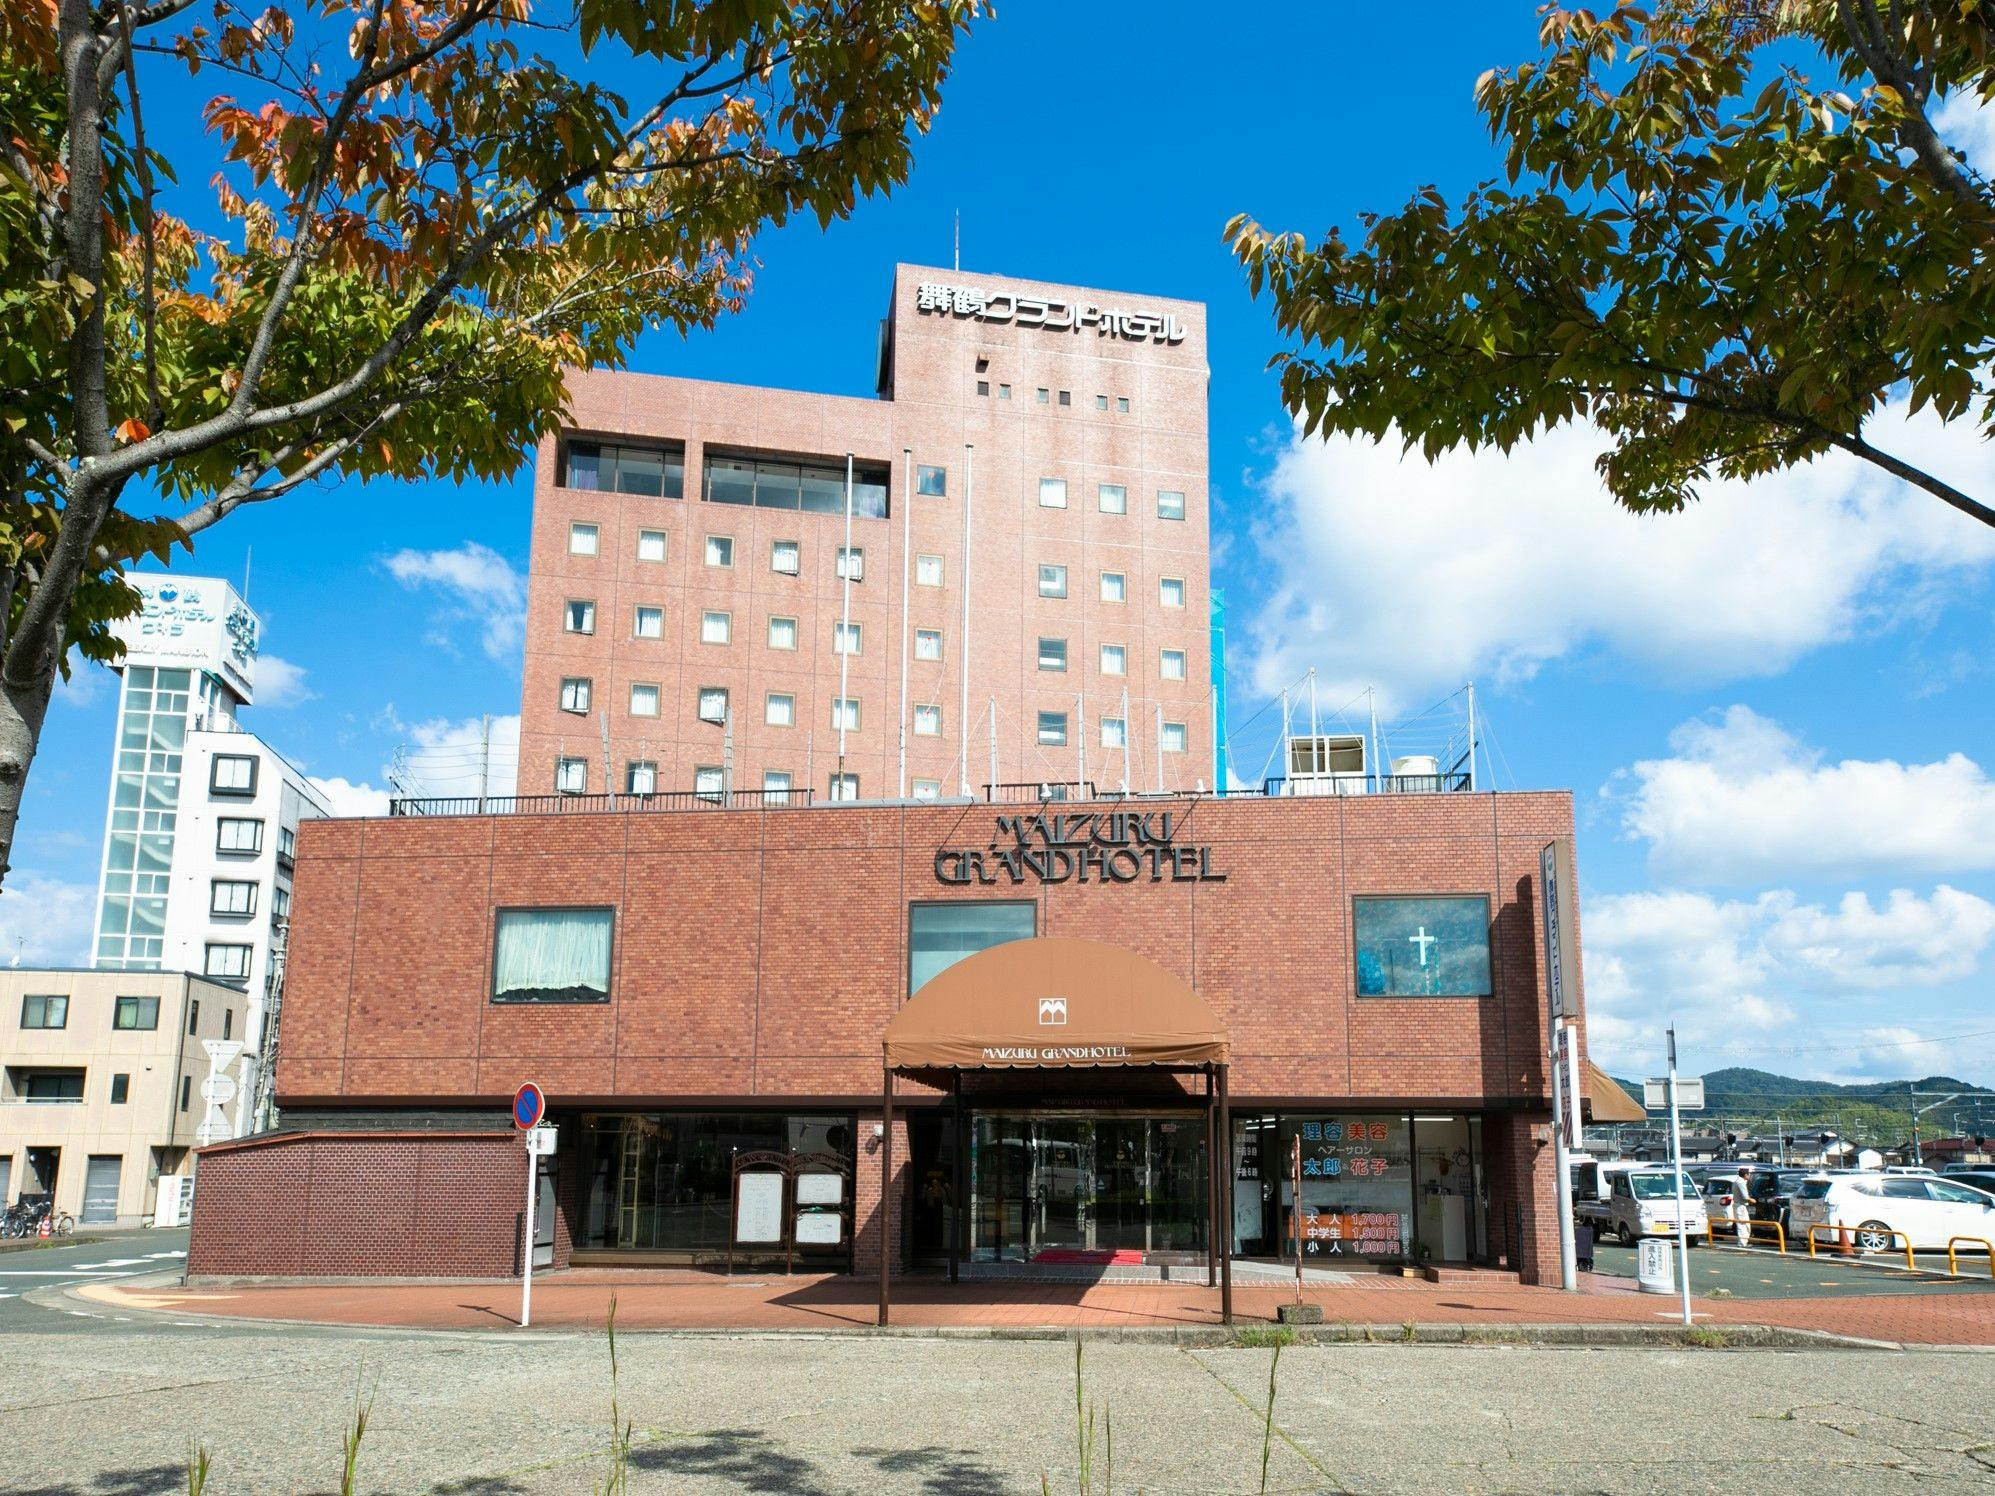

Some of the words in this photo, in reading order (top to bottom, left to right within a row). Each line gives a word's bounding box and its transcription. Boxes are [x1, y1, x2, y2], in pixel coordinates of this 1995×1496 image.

[918, 282, 1189, 344] 舞鶴グランドホテル
[990, 812, 1173, 846] MAIZURU
[982, 1047, 1037, 1060] MAIZURU
[1317, 1145, 1373, 1155] ヘアーサロン
[1307, 1227, 1342, 1239] 中学生
